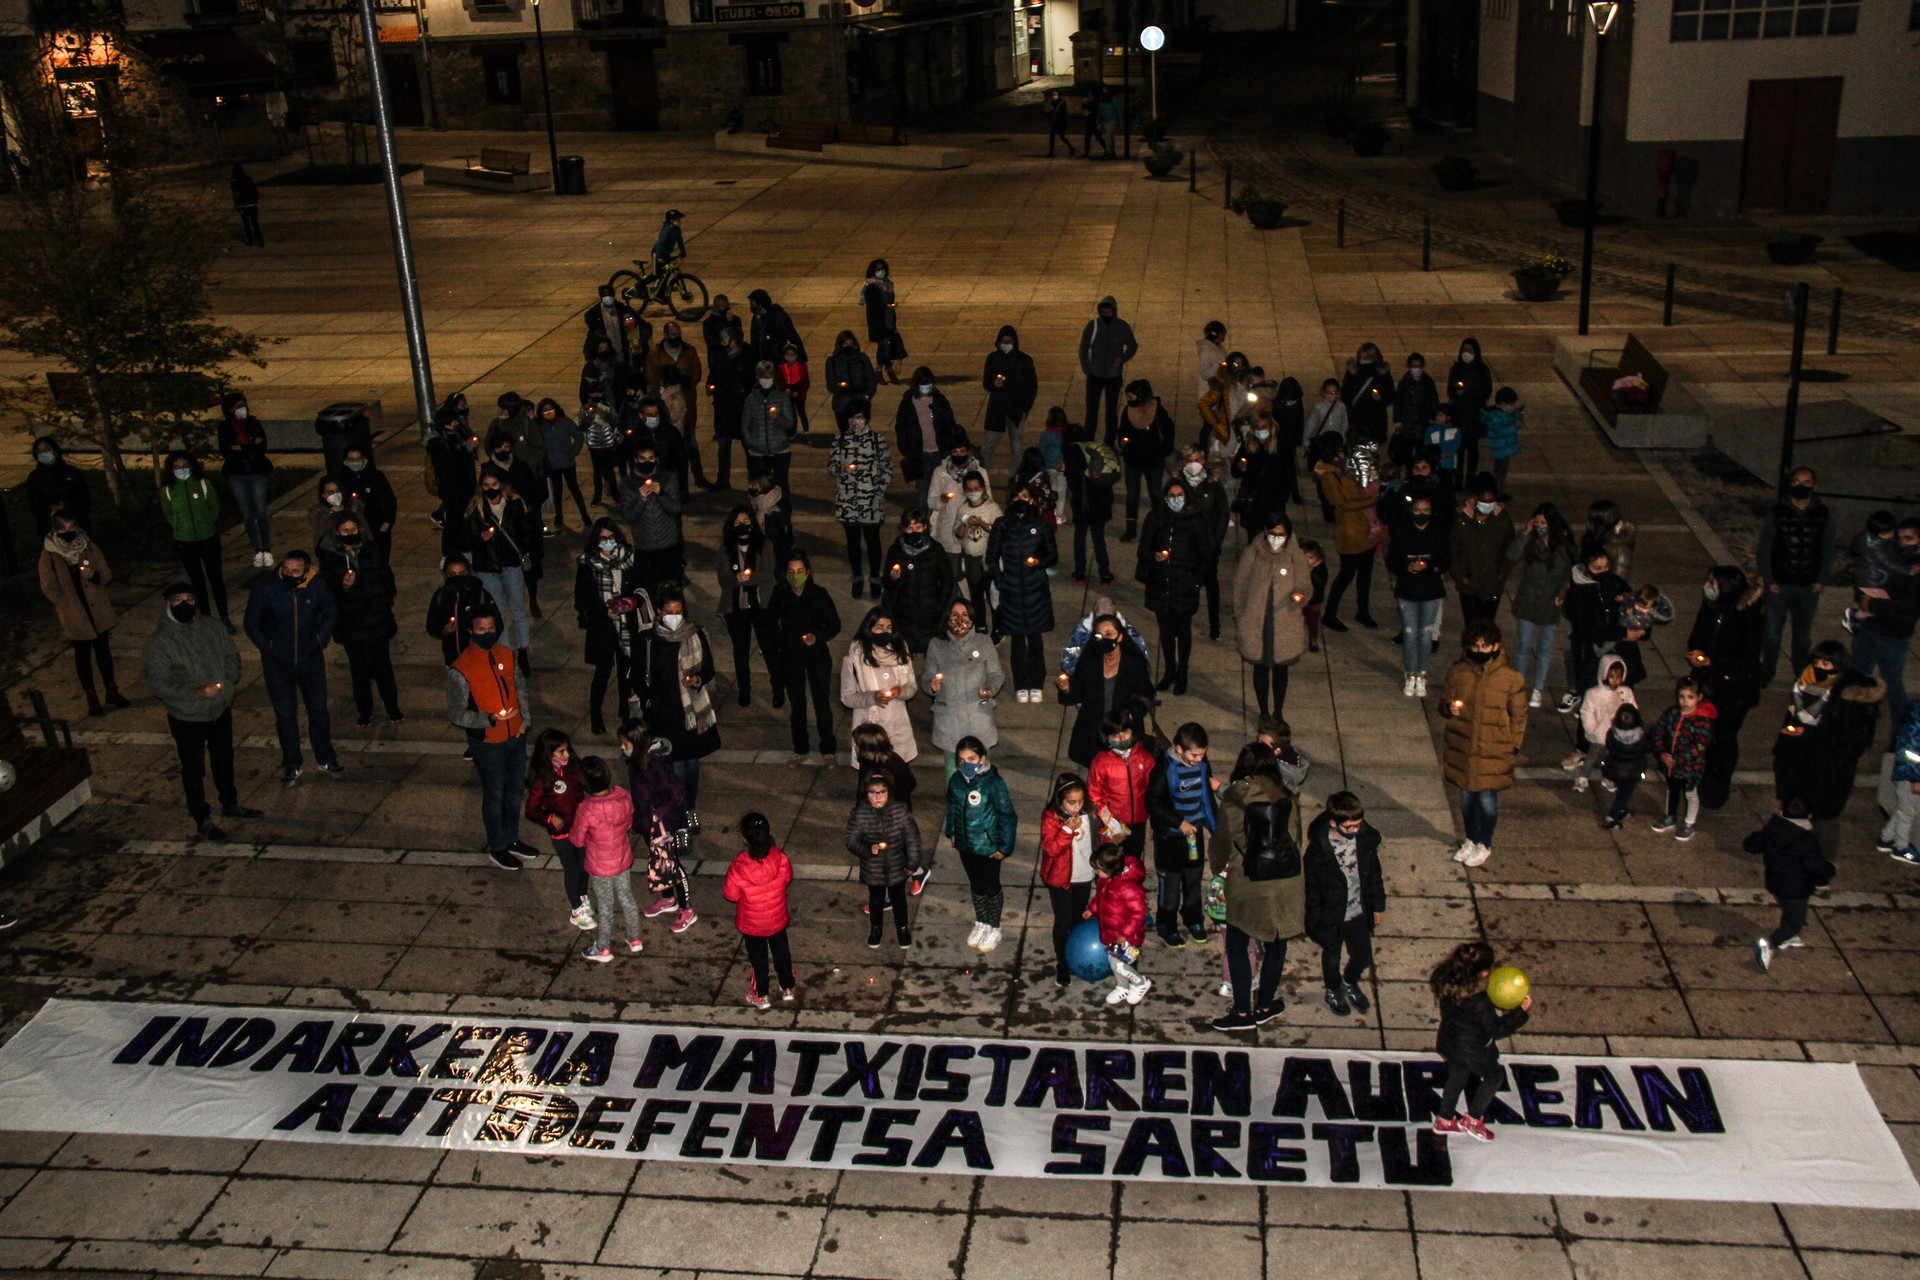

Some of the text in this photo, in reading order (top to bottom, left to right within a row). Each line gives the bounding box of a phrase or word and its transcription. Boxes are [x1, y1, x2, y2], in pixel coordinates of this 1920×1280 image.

[113, 1016, 619, 1087] INDARKERIA
[633, 1034, 1251, 1116] MATXISTAREN
[273, 1083, 1453, 1186] AUTODEFENTSA SARETU
